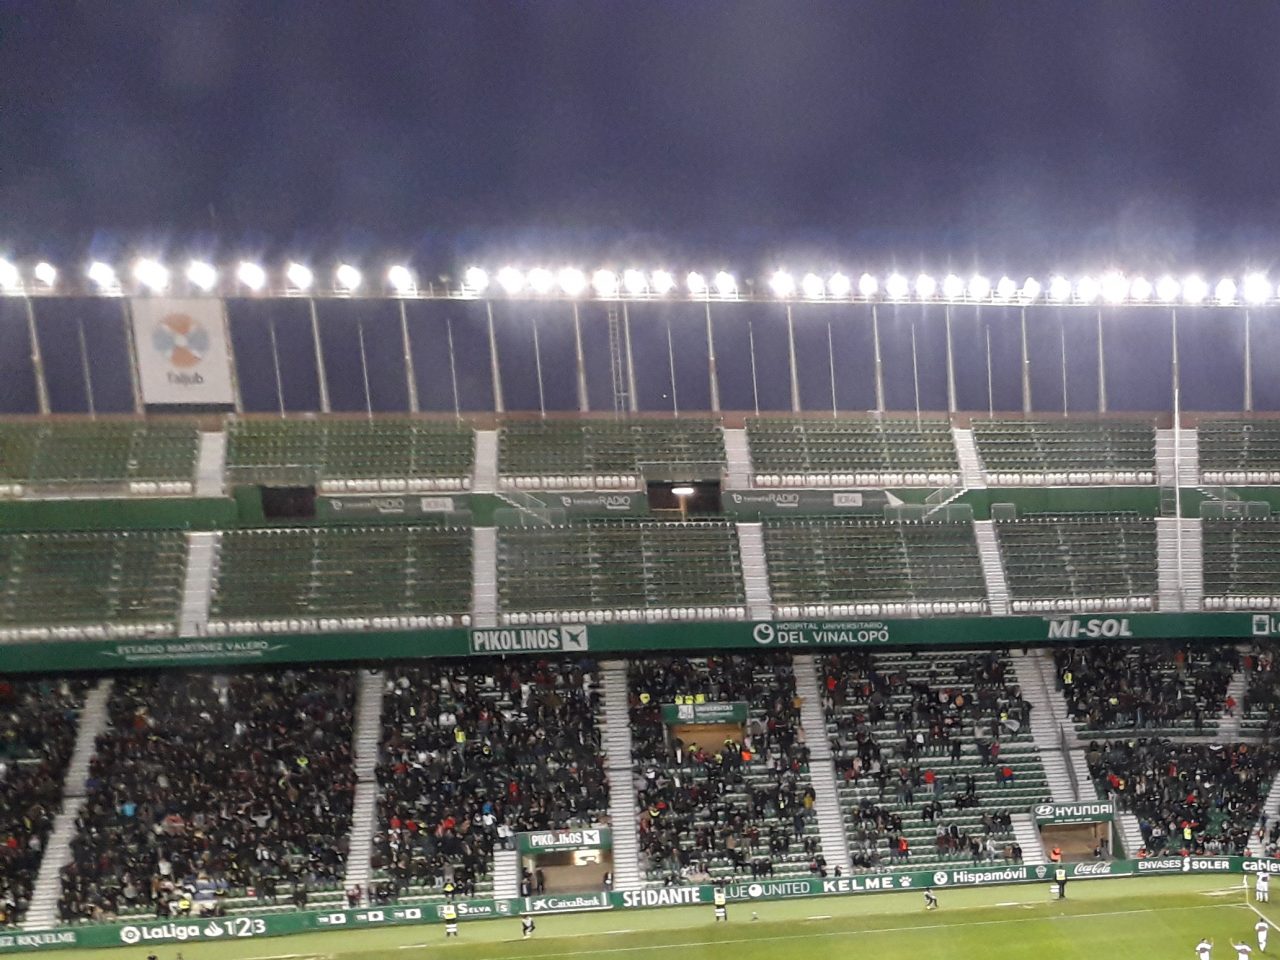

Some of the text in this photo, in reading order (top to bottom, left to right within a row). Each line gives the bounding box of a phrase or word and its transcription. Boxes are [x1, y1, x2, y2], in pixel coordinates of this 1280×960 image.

[777, 625, 889, 644] DEL VINALOPÓ
[1048, 619, 1133, 639] MI-SOL
[473, 628, 560, 651] PIKOLINOS
[1055, 804, 1113, 817] HYUNDAI
[1138, 859, 1230, 870] ENVASES SOLER
[823, 876, 894, 892] KELME
[953, 866, 1027, 884] Hispamóvil
[623, 887, 700, 907] SFIDANTE
[762, 881, 810, 896] UNITED
[548, 897, 600, 909] CaixaBank
[143, 922, 200, 940] LaLiga
